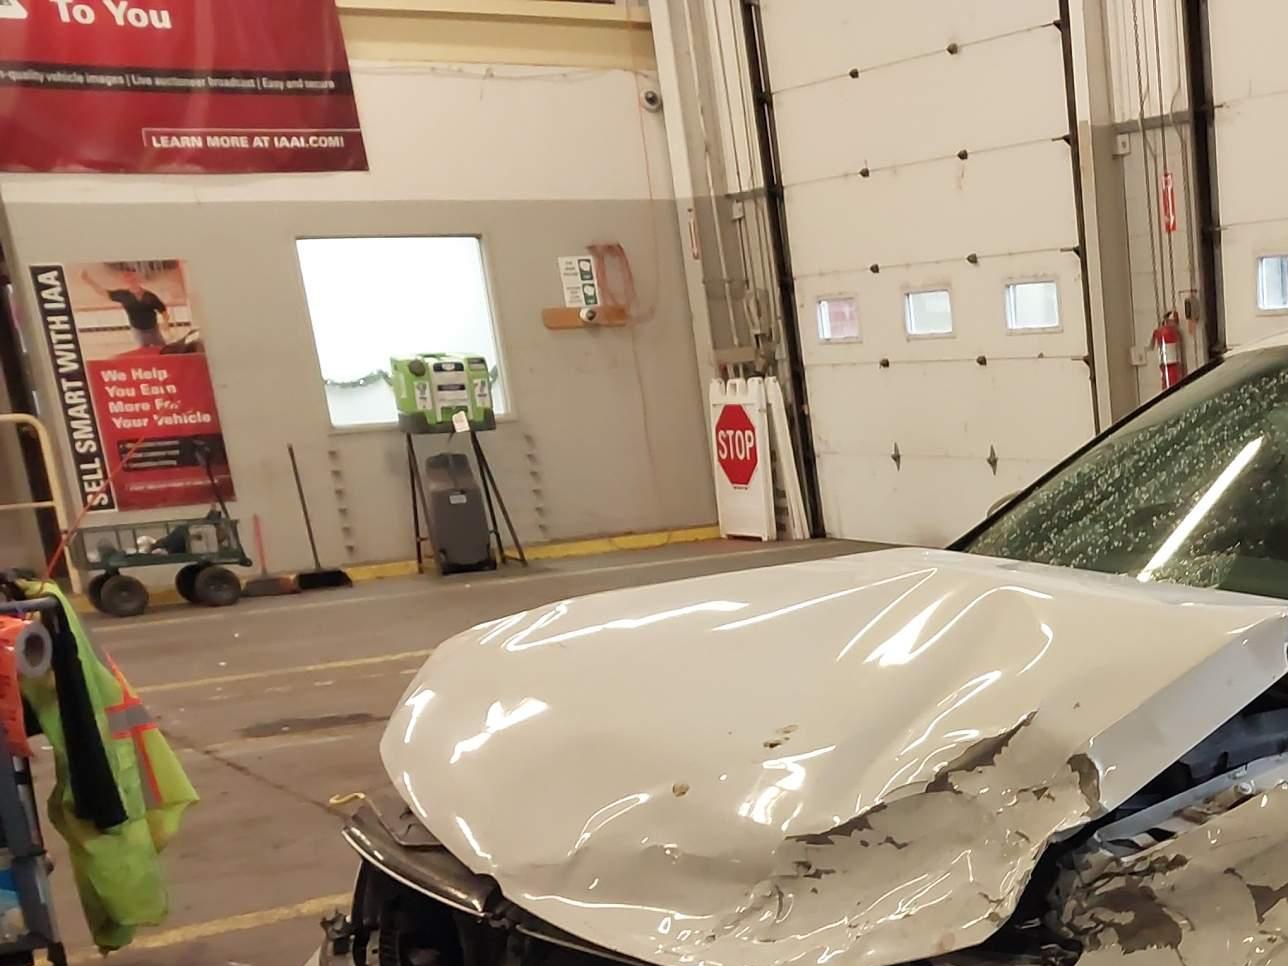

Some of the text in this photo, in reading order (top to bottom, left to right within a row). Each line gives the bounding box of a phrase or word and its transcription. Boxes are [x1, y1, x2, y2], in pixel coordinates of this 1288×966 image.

[52, 0, 172, 29] To You
[151, 135, 203, 149] LEARN
[206, 136, 249, 148] MORE
[252, 136, 271, 148] AT
[101, 367, 168, 383] We Help
[37, 270, 109, 507] SELL SMART WITH IAA
[104, 385, 136, 398] You
[108, 401, 151, 414] More
[112, 416, 149, 429] Your
[718, 430, 754, 460] STOP
